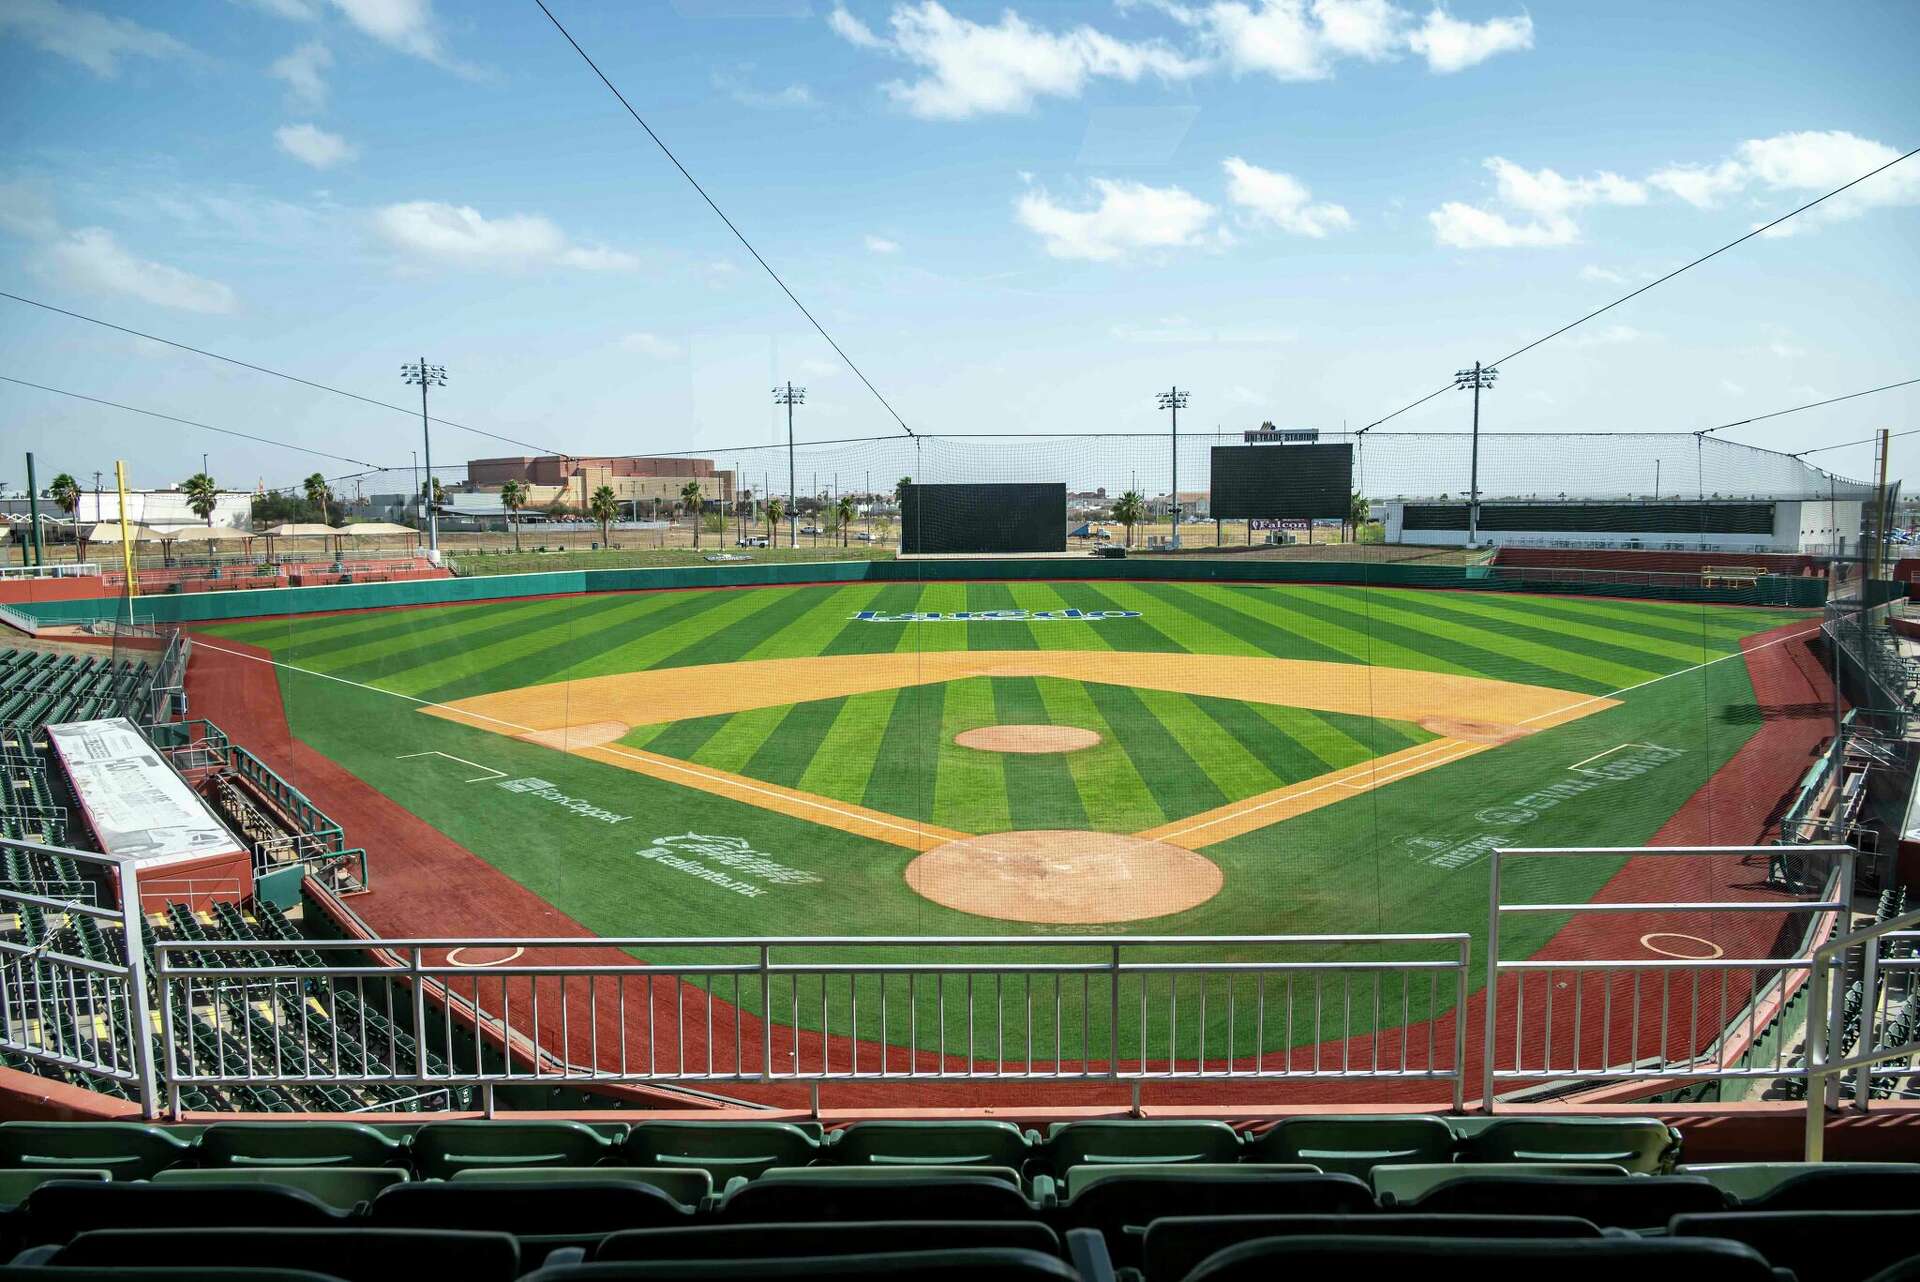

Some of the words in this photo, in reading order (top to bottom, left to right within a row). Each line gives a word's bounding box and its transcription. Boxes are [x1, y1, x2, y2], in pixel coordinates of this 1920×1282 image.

[1244, 433, 1281, 442] UNI-TRADE
[1285, 432, 1318, 441] STADIUM
[1260, 518, 1307, 528] Falcon
